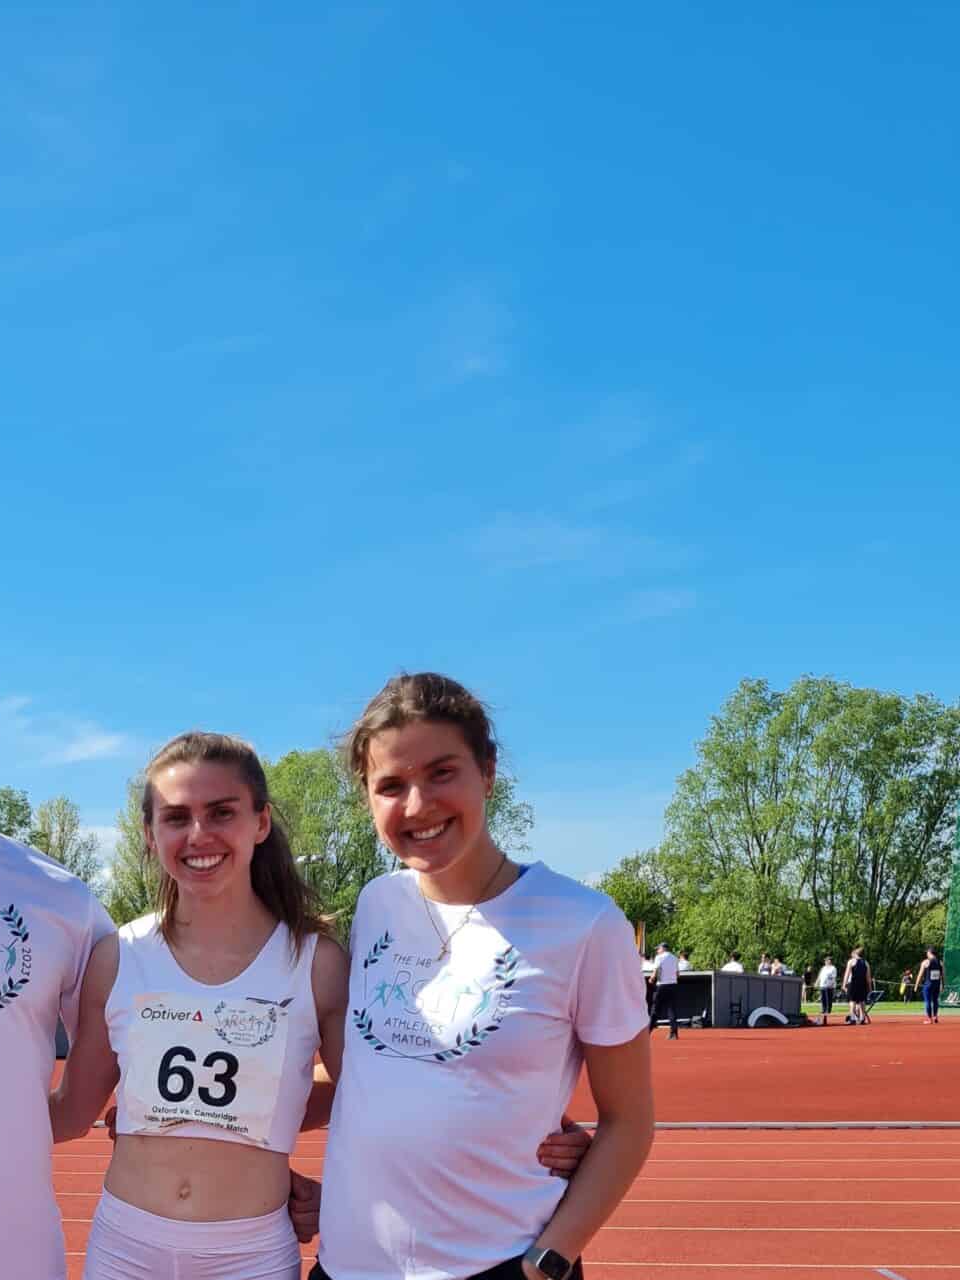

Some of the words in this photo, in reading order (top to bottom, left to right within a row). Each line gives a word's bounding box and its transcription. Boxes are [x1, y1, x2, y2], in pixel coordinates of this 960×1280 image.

[393, 953, 412, 966] THE
[140, 1007, 192, 1022] Optiver
[391, 1033, 432, 1048] MATCH
[158, 1046, 239, 1107] 63
[152, 1105, 178, 1114] Oxford
[193, 1108, 238, 1122] Cambridge
